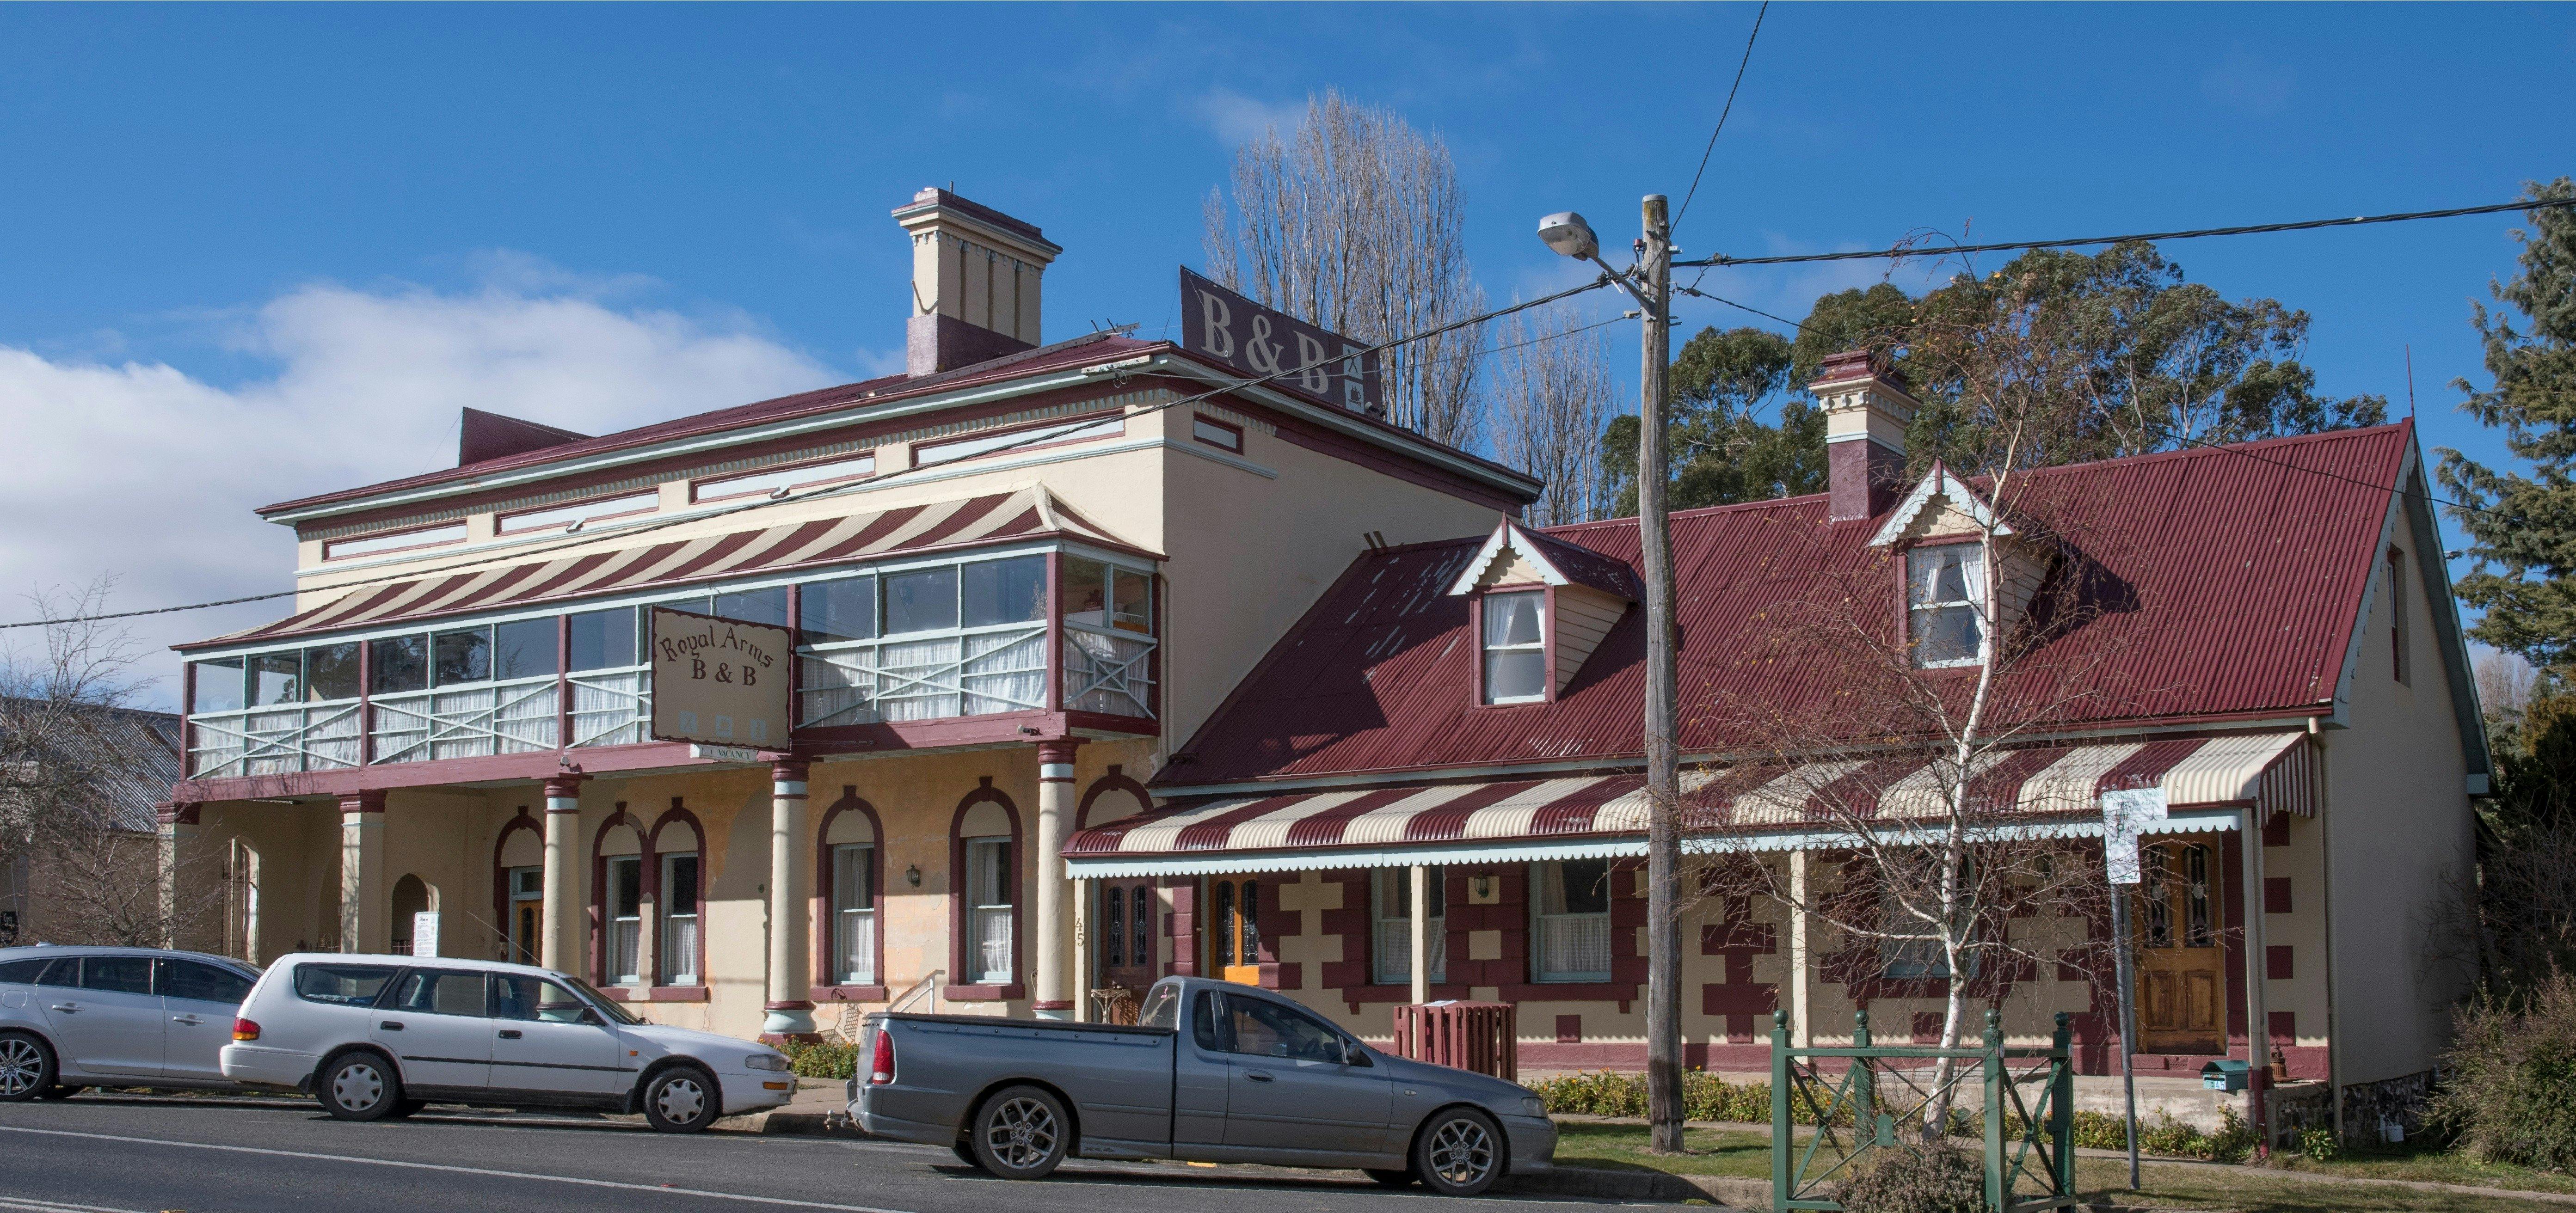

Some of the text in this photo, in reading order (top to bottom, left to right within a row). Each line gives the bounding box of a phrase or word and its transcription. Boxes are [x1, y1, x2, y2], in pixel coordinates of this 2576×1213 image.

[1198, 288, 1328, 394] B & B
[659, 624, 774, 668] Royal Arms
[691, 658, 757, 686] B & B
[718, 749, 751, 760] VACANCY
[2138, 790, 2164, 798] PARKING
